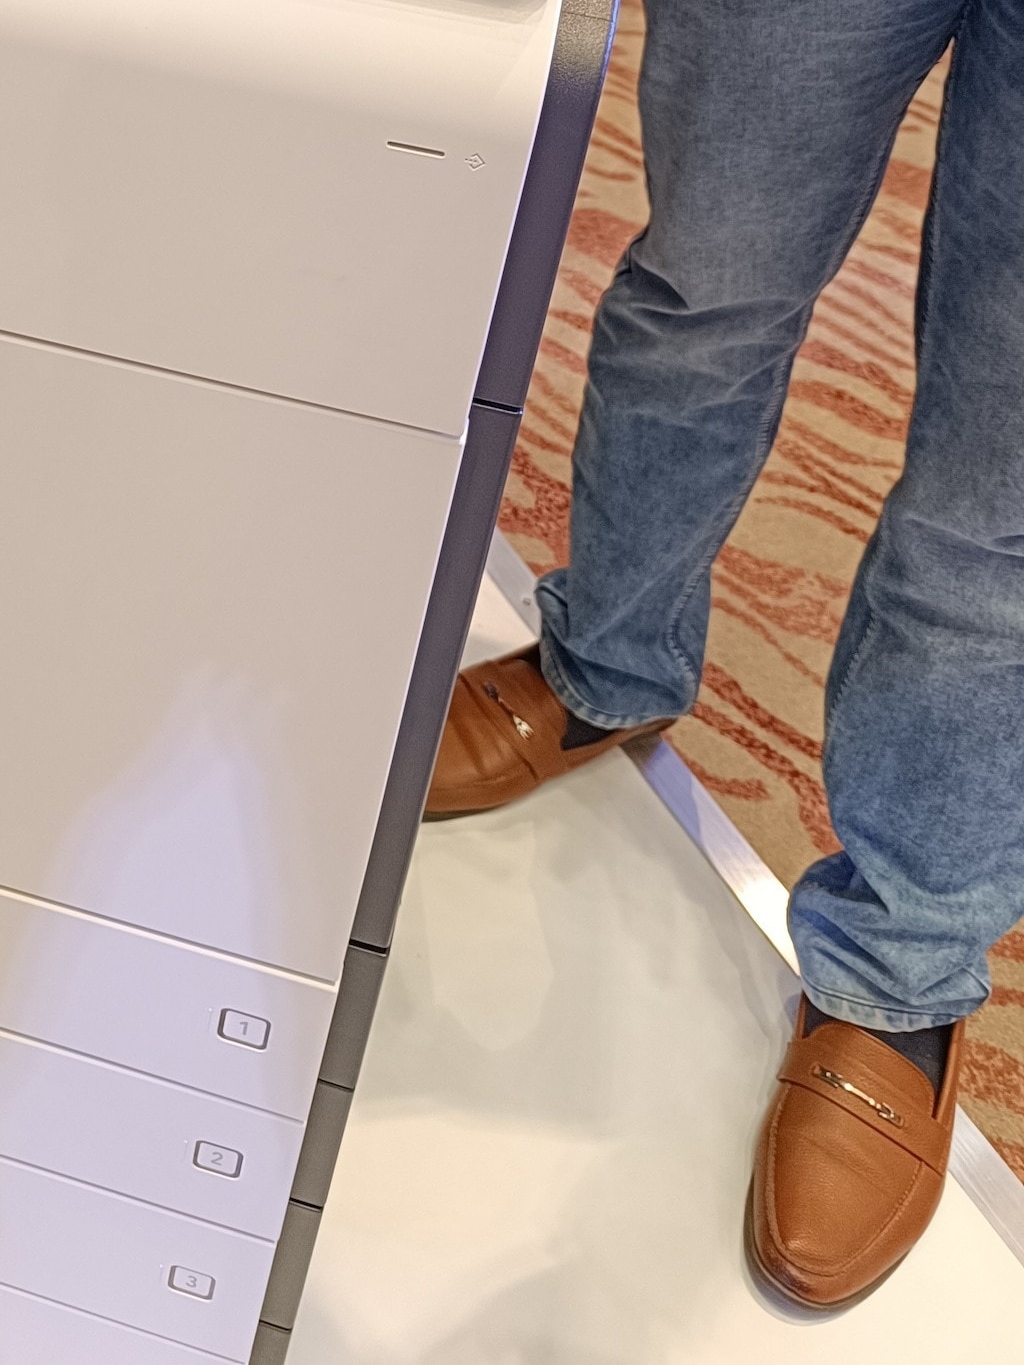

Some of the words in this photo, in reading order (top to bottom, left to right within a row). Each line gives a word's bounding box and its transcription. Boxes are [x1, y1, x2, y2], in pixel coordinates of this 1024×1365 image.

[239, 1021, 249, 1036] 1
[210, 1151, 224, 1166] 2
[185, 1275, 197, 1289] 3
